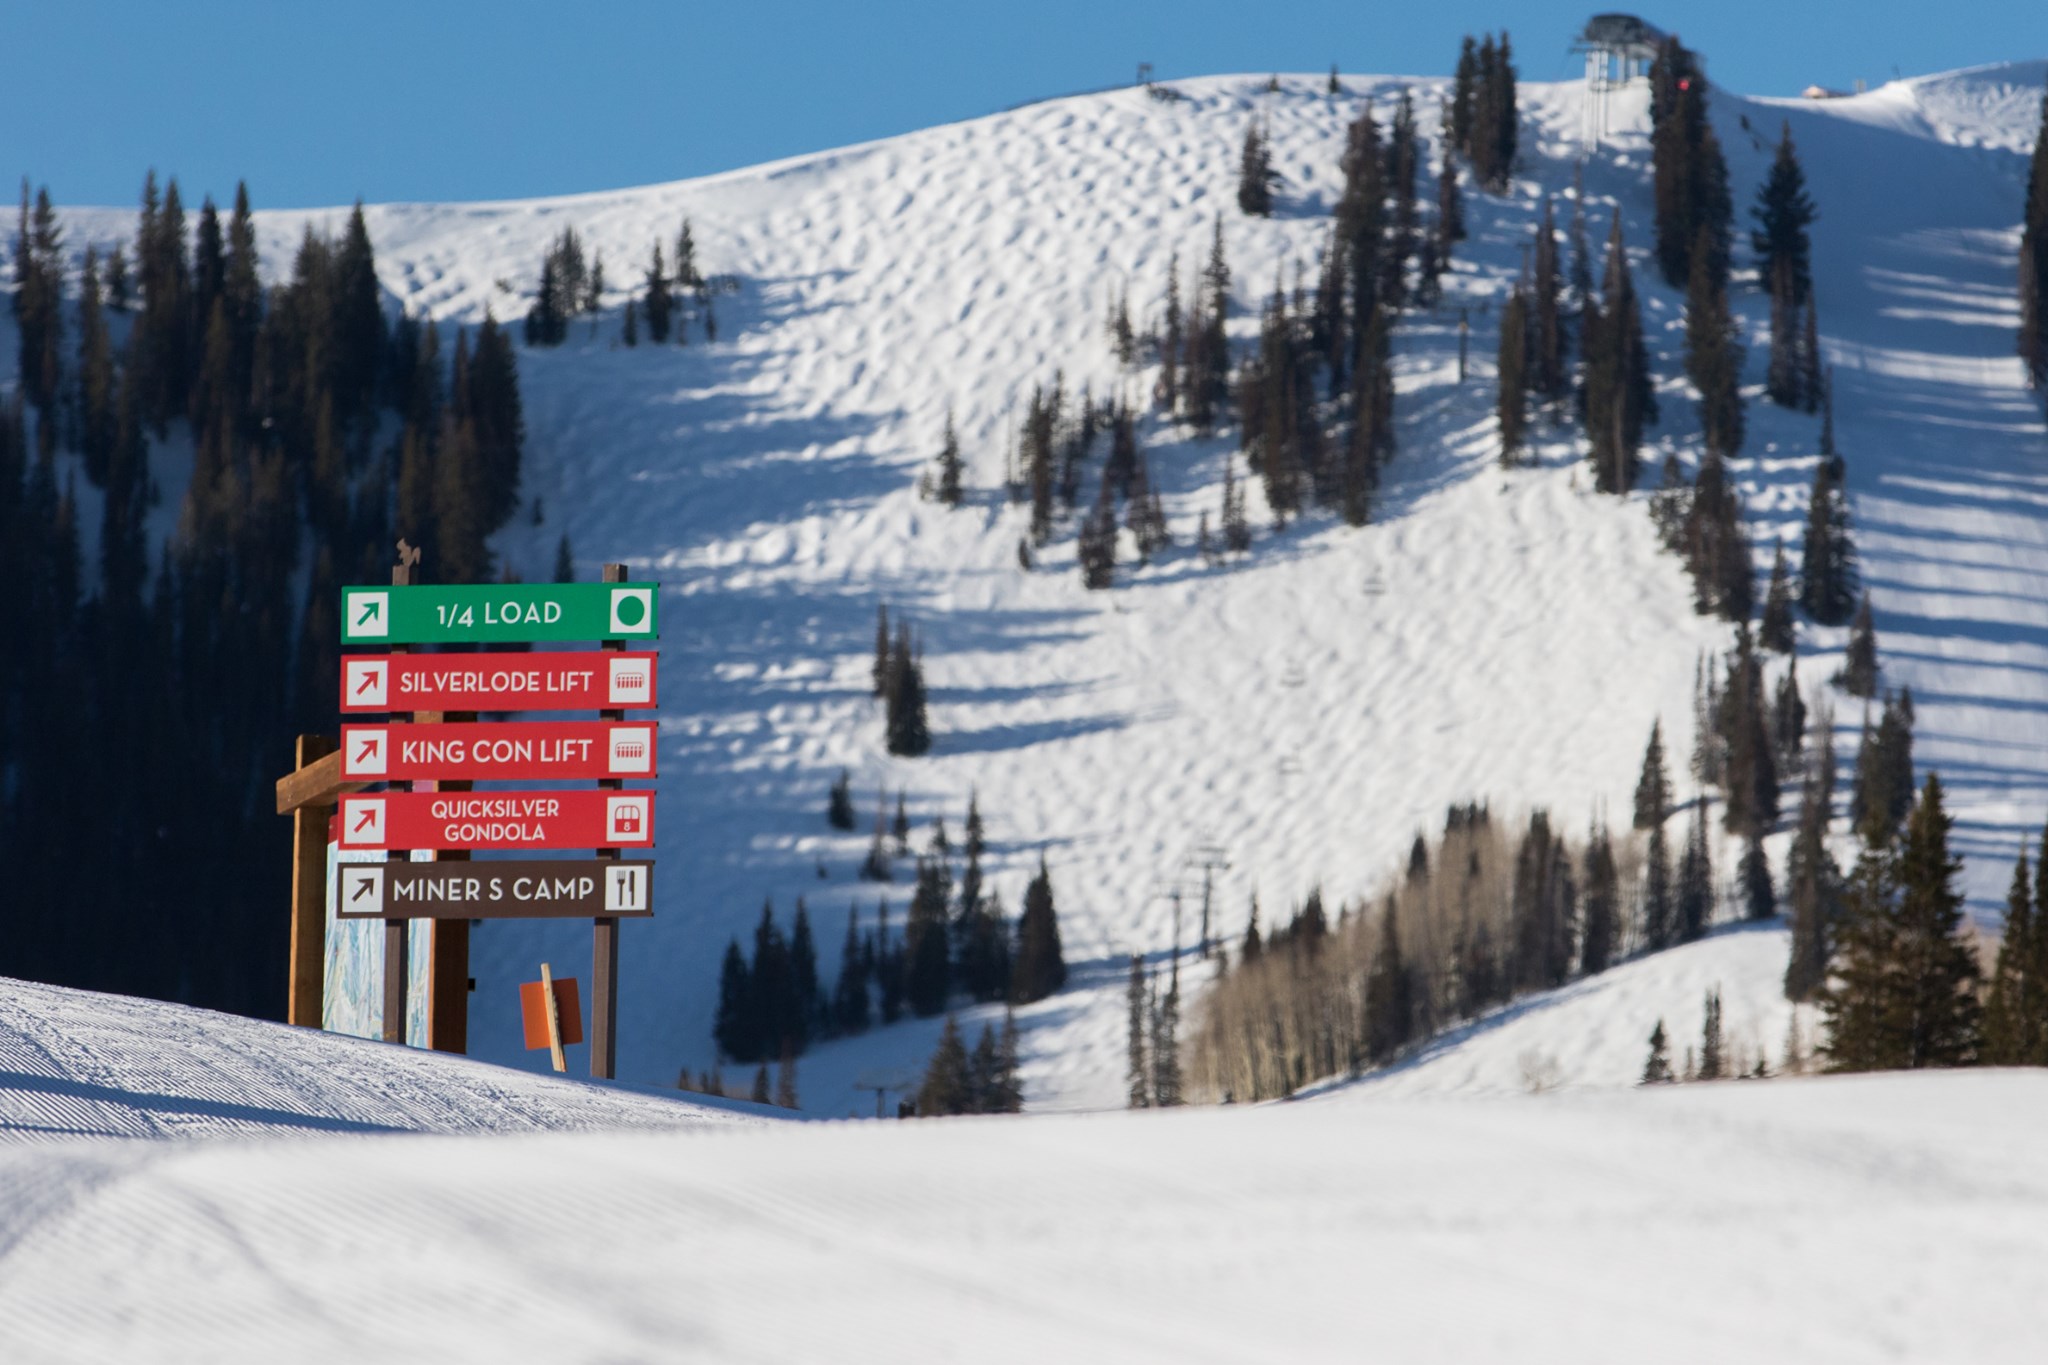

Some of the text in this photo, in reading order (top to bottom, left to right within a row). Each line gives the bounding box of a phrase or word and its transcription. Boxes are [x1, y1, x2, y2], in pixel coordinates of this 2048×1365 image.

[436, 601, 562, 628] 1/4 LOAD
[399, 671, 594, 693] SILVERLODE LIFT
[402, 739, 593, 764] KING CON LIFT
[431, 799, 560, 819] QUICKSILVER
[444, 823, 546, 842] GONDOLA
[623, 821, 632, 832] 8
[512, 876, 595, 901] CAMP
